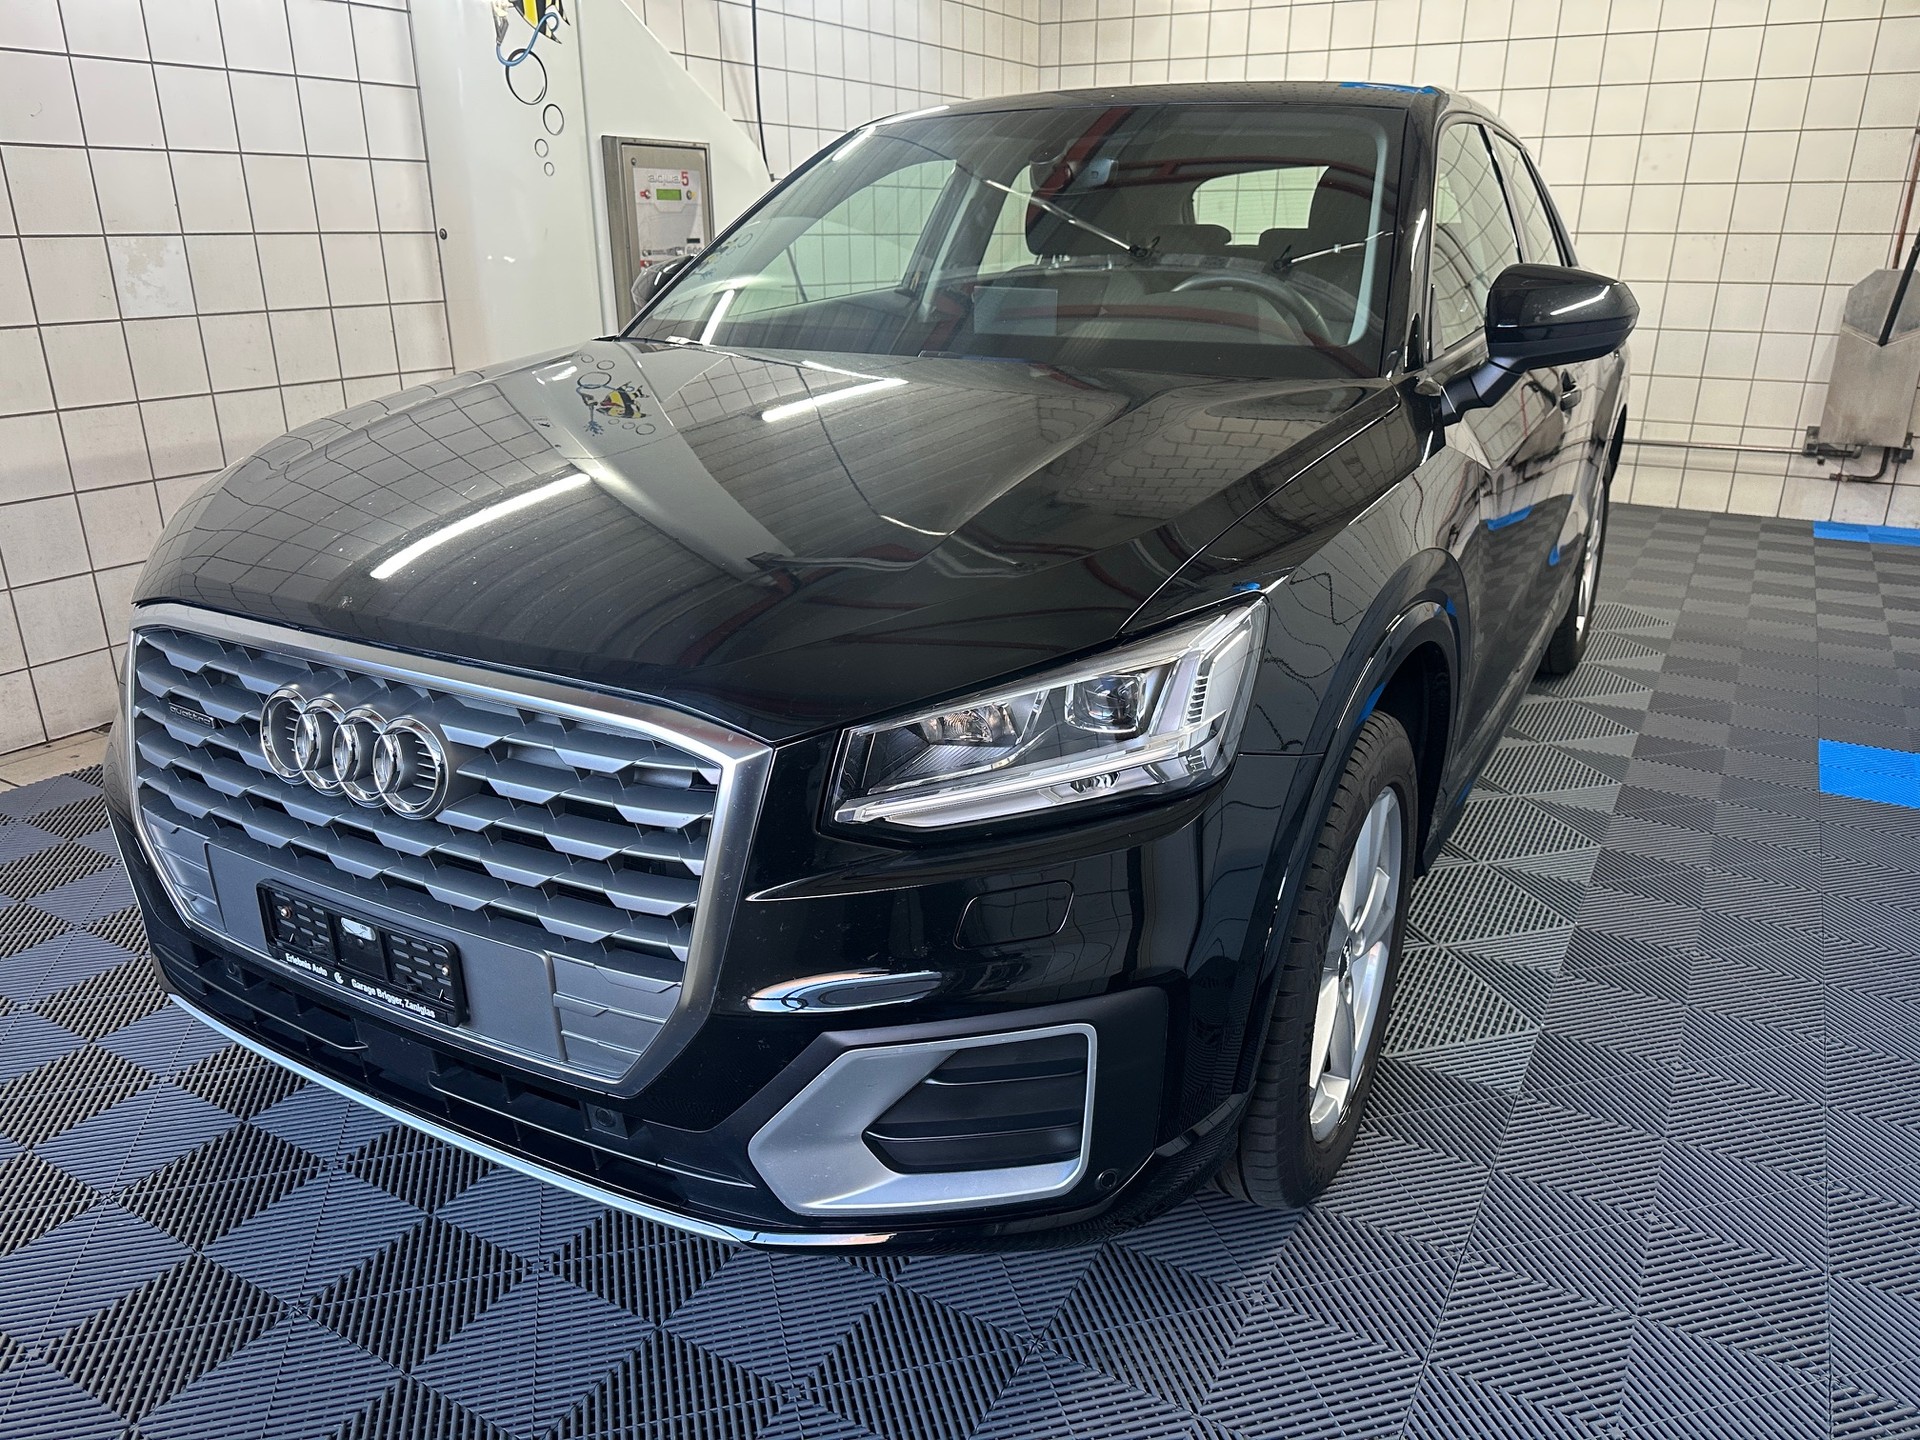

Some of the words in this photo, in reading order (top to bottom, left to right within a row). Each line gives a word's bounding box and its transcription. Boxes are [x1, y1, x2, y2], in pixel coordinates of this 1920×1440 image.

[169, 706, 211, 724] quattro
[285, 953, 312, 970] Erlebnis
[312, 963, 328, 977] Auto
[351, 978, 376, 996] Garage
[376, 988, 404, 1008] Brigger,
[404, 998, 436, 1019] Zaniglas
